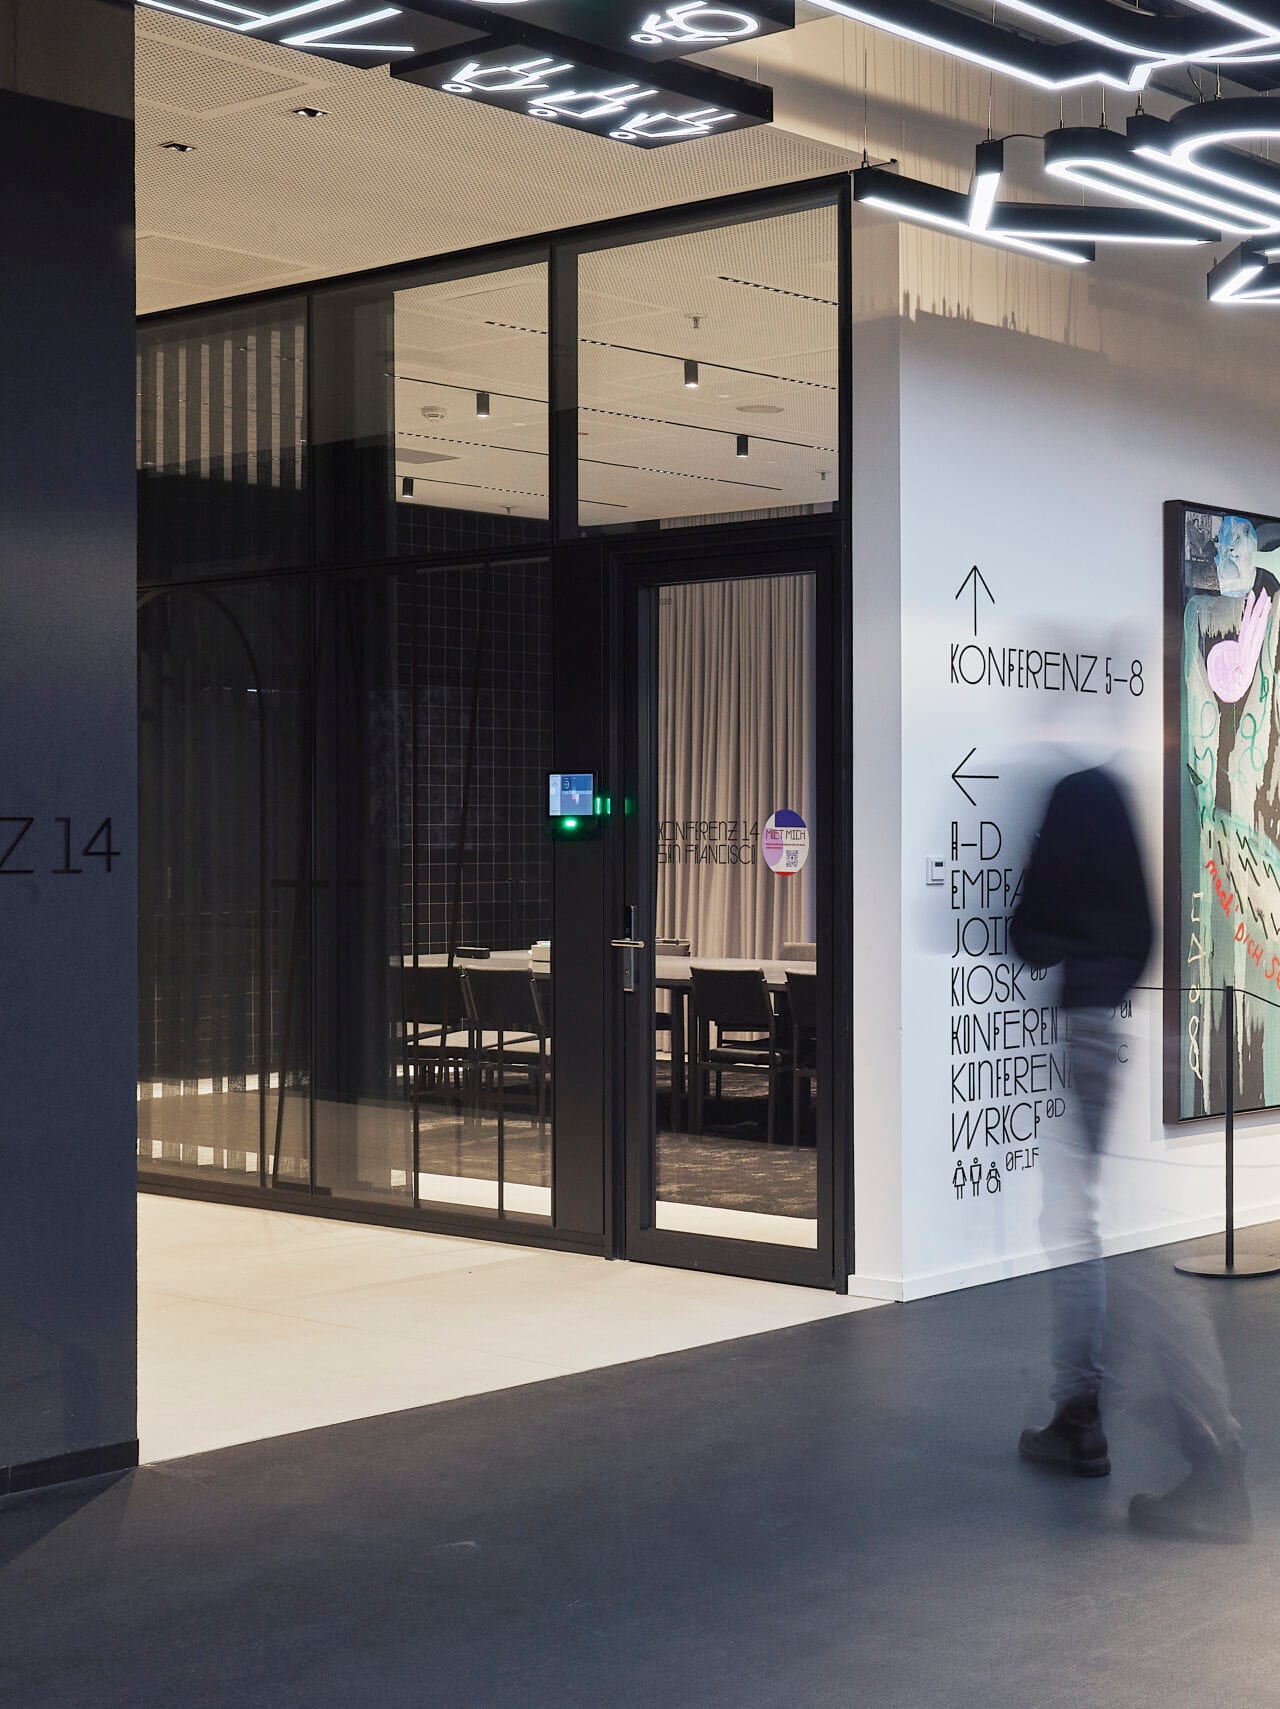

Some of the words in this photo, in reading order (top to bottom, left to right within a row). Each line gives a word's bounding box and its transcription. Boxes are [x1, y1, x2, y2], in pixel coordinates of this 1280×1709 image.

[951, 643, 1097, 693] KONFERENZ
[52, 817, 121, 874] 14
[742, 820, 760, 841] 14
[951, 962, 1027, 1007] KIOSK
